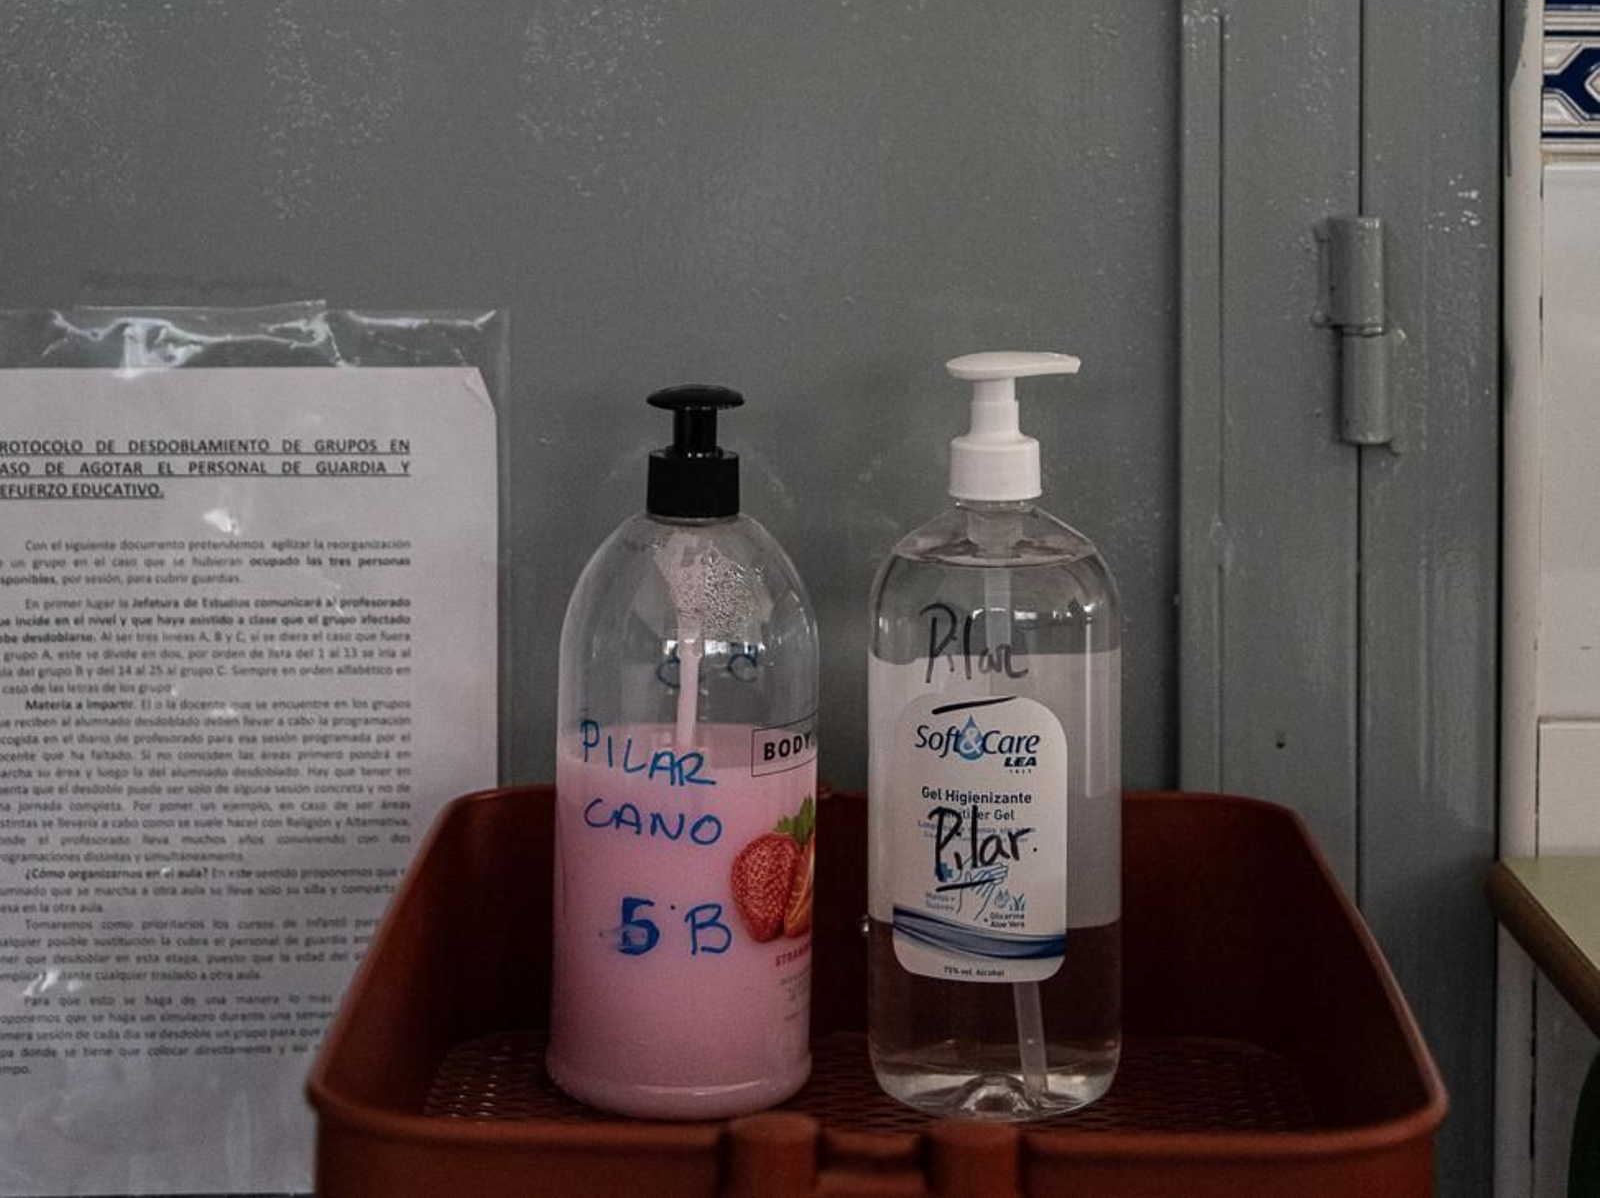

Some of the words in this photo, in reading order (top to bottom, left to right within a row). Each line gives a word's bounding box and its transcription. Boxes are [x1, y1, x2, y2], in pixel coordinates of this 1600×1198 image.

[95, 439, 116, 452] DE
[128, 438, 270, 452] DESDOBLAMIENTO
[281, 439, 302, 452] DE
[314, 438, 378, 452] GRUPOS
[390, 438, 410, 451] EN
[44, 461, 65, 475] DE
[79, 461, 144, 475] AGOTAR
[157, 461, 173, 475] EL
[188, 460, 268, 474] PERSONAL
[281, 460, 301, 474] DE
[315, 460, 387, 474] GUARDIA
[400, 460, 410, 473] Y
[72, 482, 164, 498] EDUCATIVO.
[24, 538, 47, 550] Con
[50, 538, 62, 550] el
[64, 537, 116, 553] siguiente
[119, 537, 185, 550] documento
[187, 537, 264, 553] pretendemos
[271, 537, 310, 553] agilizar
[326, 537, 410, 553] reorganización
[10, 559, 25, 567] un
[31, 558, 66, 570] grupo
[72, 558, 88, 567] en
[93, 554, 105, 567] el
[111, 558, 137, 567] caso
[143, 558, 165, 570] que
[172, 558, 185, 567] se
[191, 554, 242, 567] hubieran
[248, 554, 300, 570] ocupado
[305, 554, 323, 566] las
[357, 558, 411, 570] personas
[61, 575, 81, 587] por
[126, 575, 152, 587] para
[154, 571, 188, 584] cubrir
[24, 596, 39, 608] En
[43, 596, 81, 612] primer
[85, 596, 114, 612] lugar
[132, 595, 179, 608] Jefatura
[183, 595, 198, 608] de
[254, 595, 322, 607] comunicará
[339, 595, 410, 611] profesorado
[14, 613, 50, 625] incide
[54, 617, 69, 625] en
[88, 613, 116, 625] nivel
[130, 616, 152, 628] que
[156, 612, 185, 628] haya
[248, 612, 277, 624] clase
[281, 616, 303, 628] que
[321, 616, 356, 628] grupo
[360, 612, 410, 624] afectado
[914, 714, 1041, 760] Soft&Care
[579, 719, 717, 786] PILAR
[763, 733, 812, 761] BODY
[1003, 756, 1037, 768] LEA
[921, 785, 942, 801] Gel
[945, 787, 1032, 806] Higienizante
[584, 798, 722, 846] CANO
[993, 808, 1015, 820] Gel
[617, 896, 660, 956] 5
[684, 902, 733, 956] B
